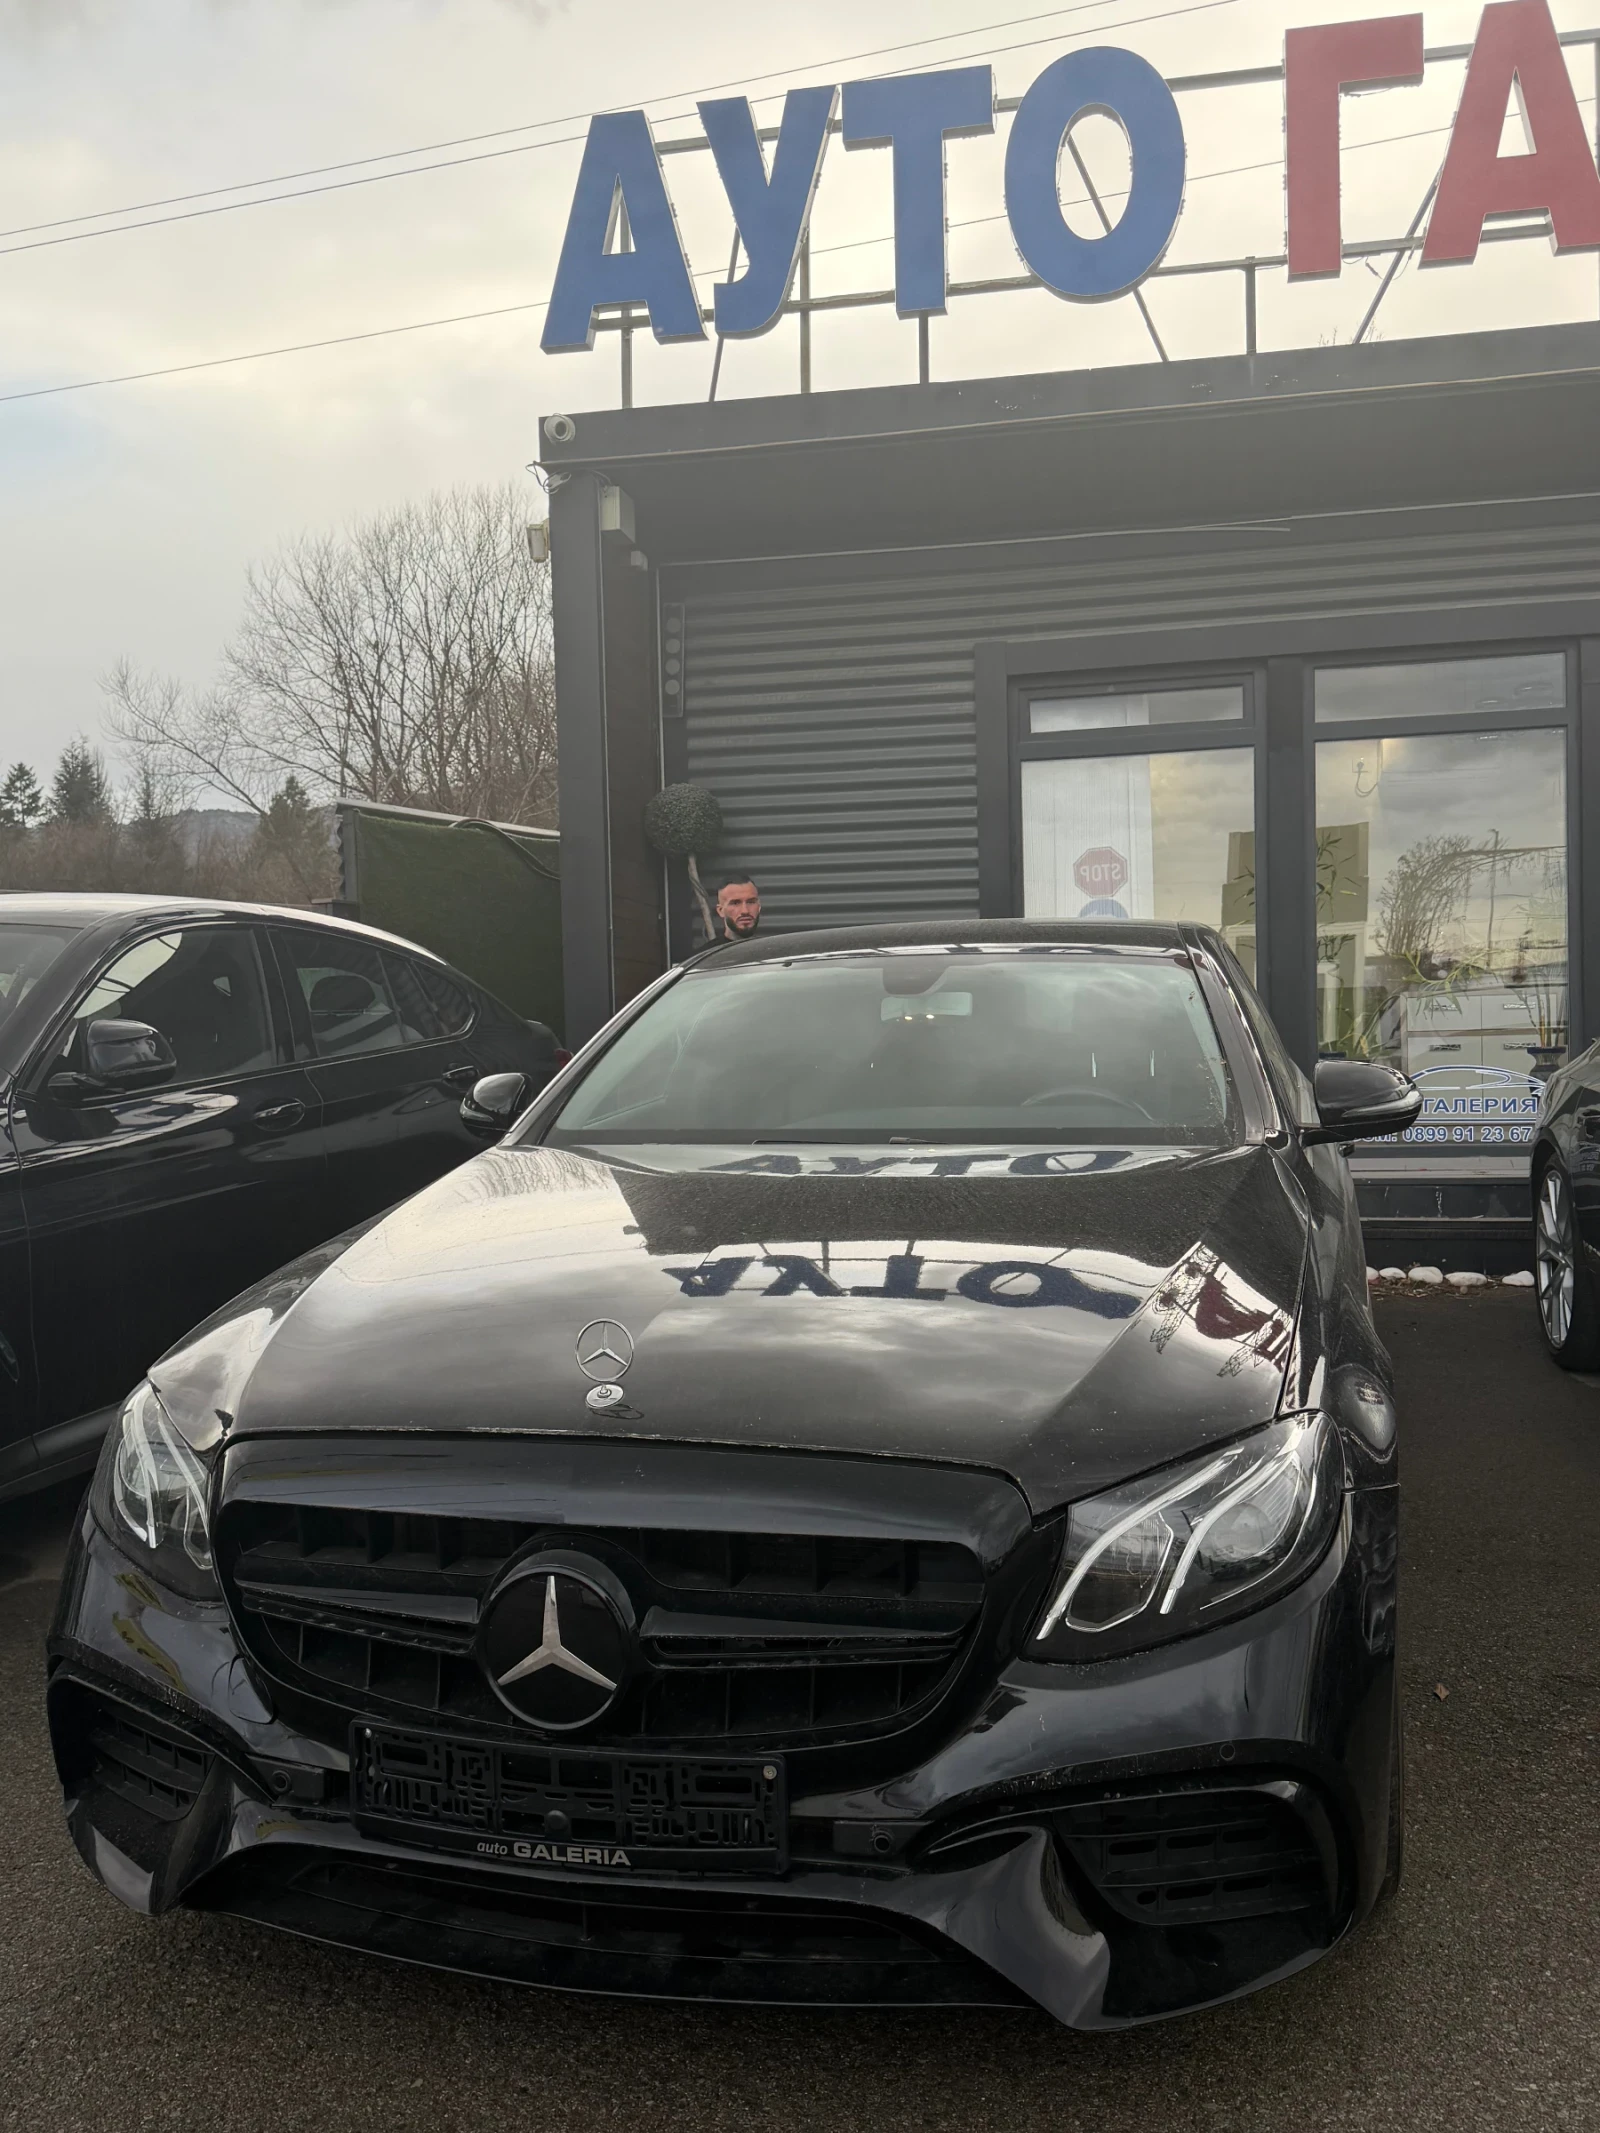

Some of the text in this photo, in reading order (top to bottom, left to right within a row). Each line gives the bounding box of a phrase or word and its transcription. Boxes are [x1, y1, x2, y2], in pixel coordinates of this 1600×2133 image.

[539, 45, 1186, 353] АУТО
[1423, 1097, 1538, 1114] ГАЛЕРИЯ
[1402, 1126, 1448, 1142] 0899
[1452, 1126, 1474, 1142] 91
[1480, 1126, 1504, 1142] 23
[1508, 1126, 1532, 1142] 67
[476, 1841, 631, 1867] auto GALERIA
